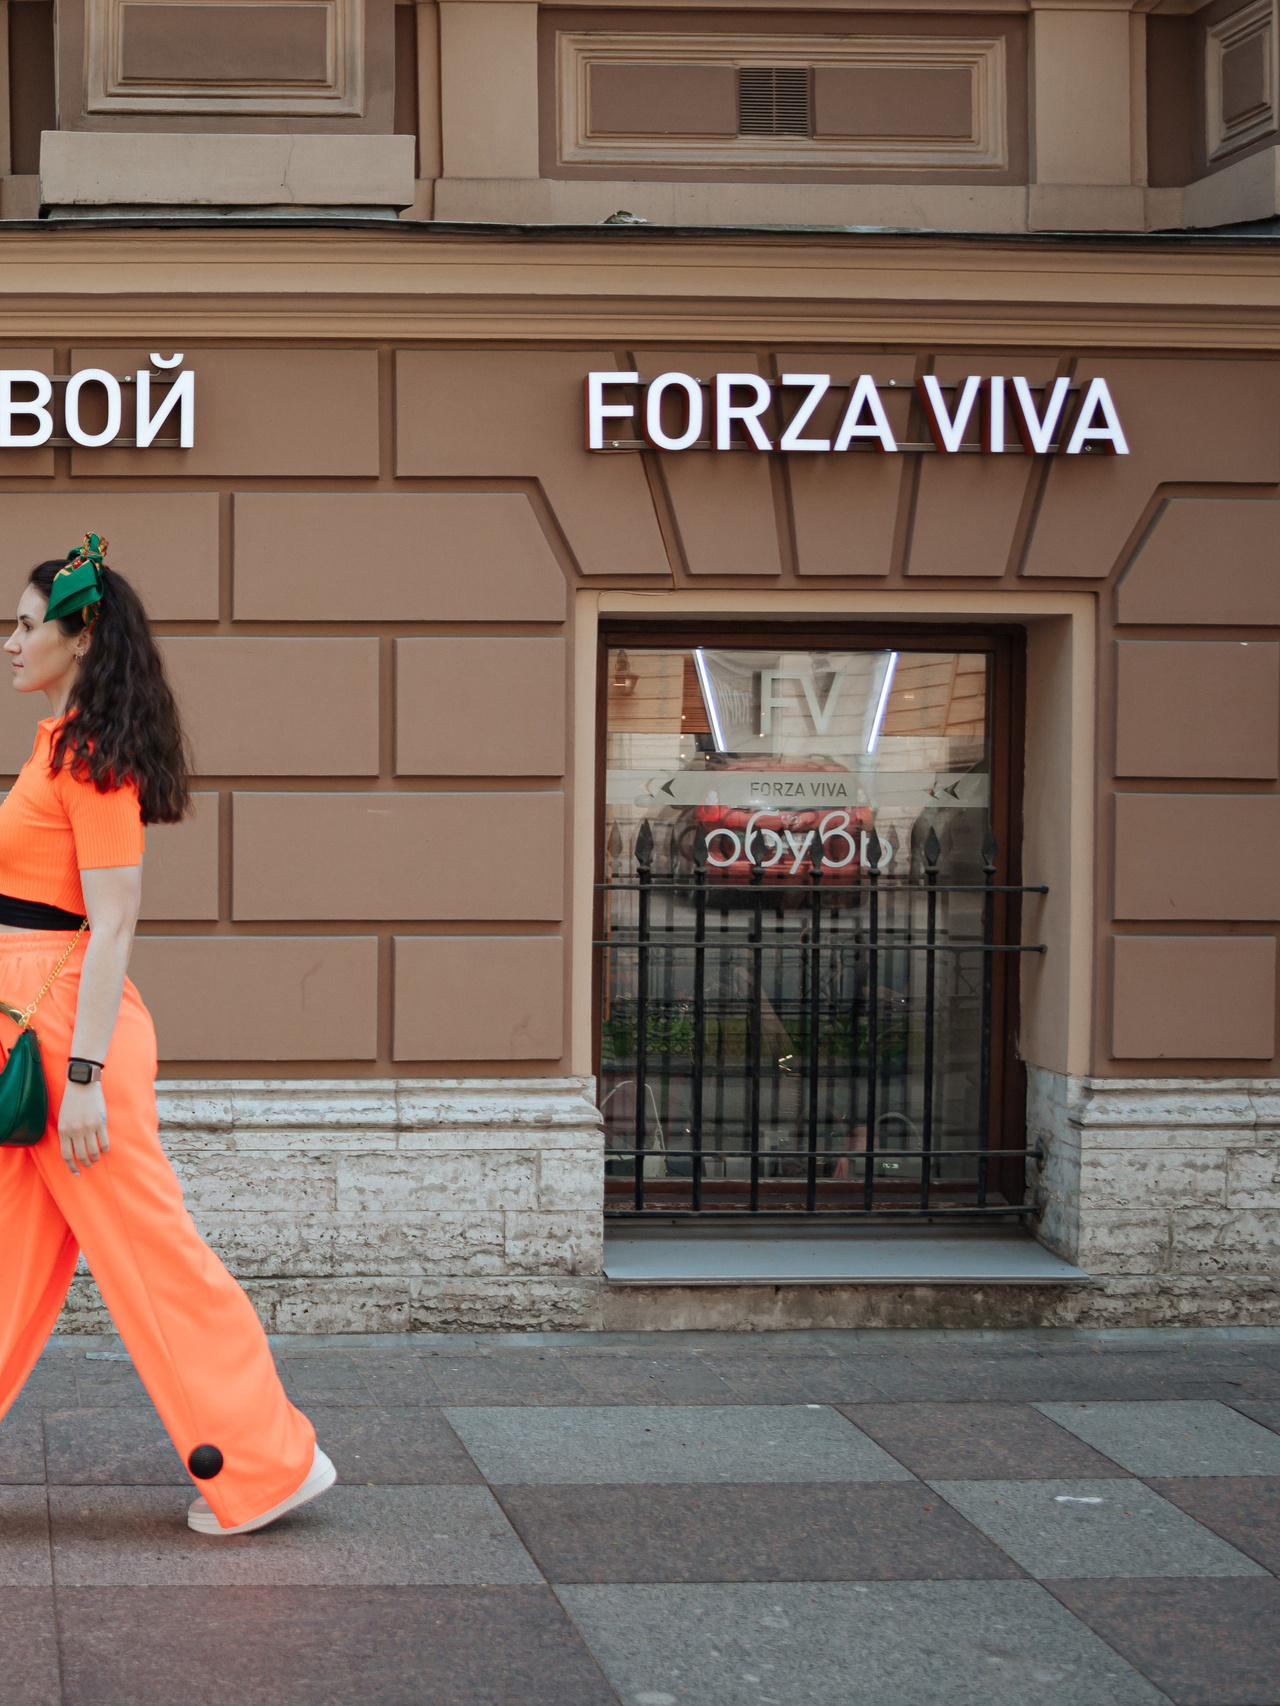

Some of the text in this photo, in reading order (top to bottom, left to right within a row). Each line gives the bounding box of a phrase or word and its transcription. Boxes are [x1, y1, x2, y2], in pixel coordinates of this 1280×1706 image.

[586, 371, 1130, 455] FORZA VIVA
[760, 669, 845, 735] FV
[750, 782, 847, 797] FORZA VIVA
